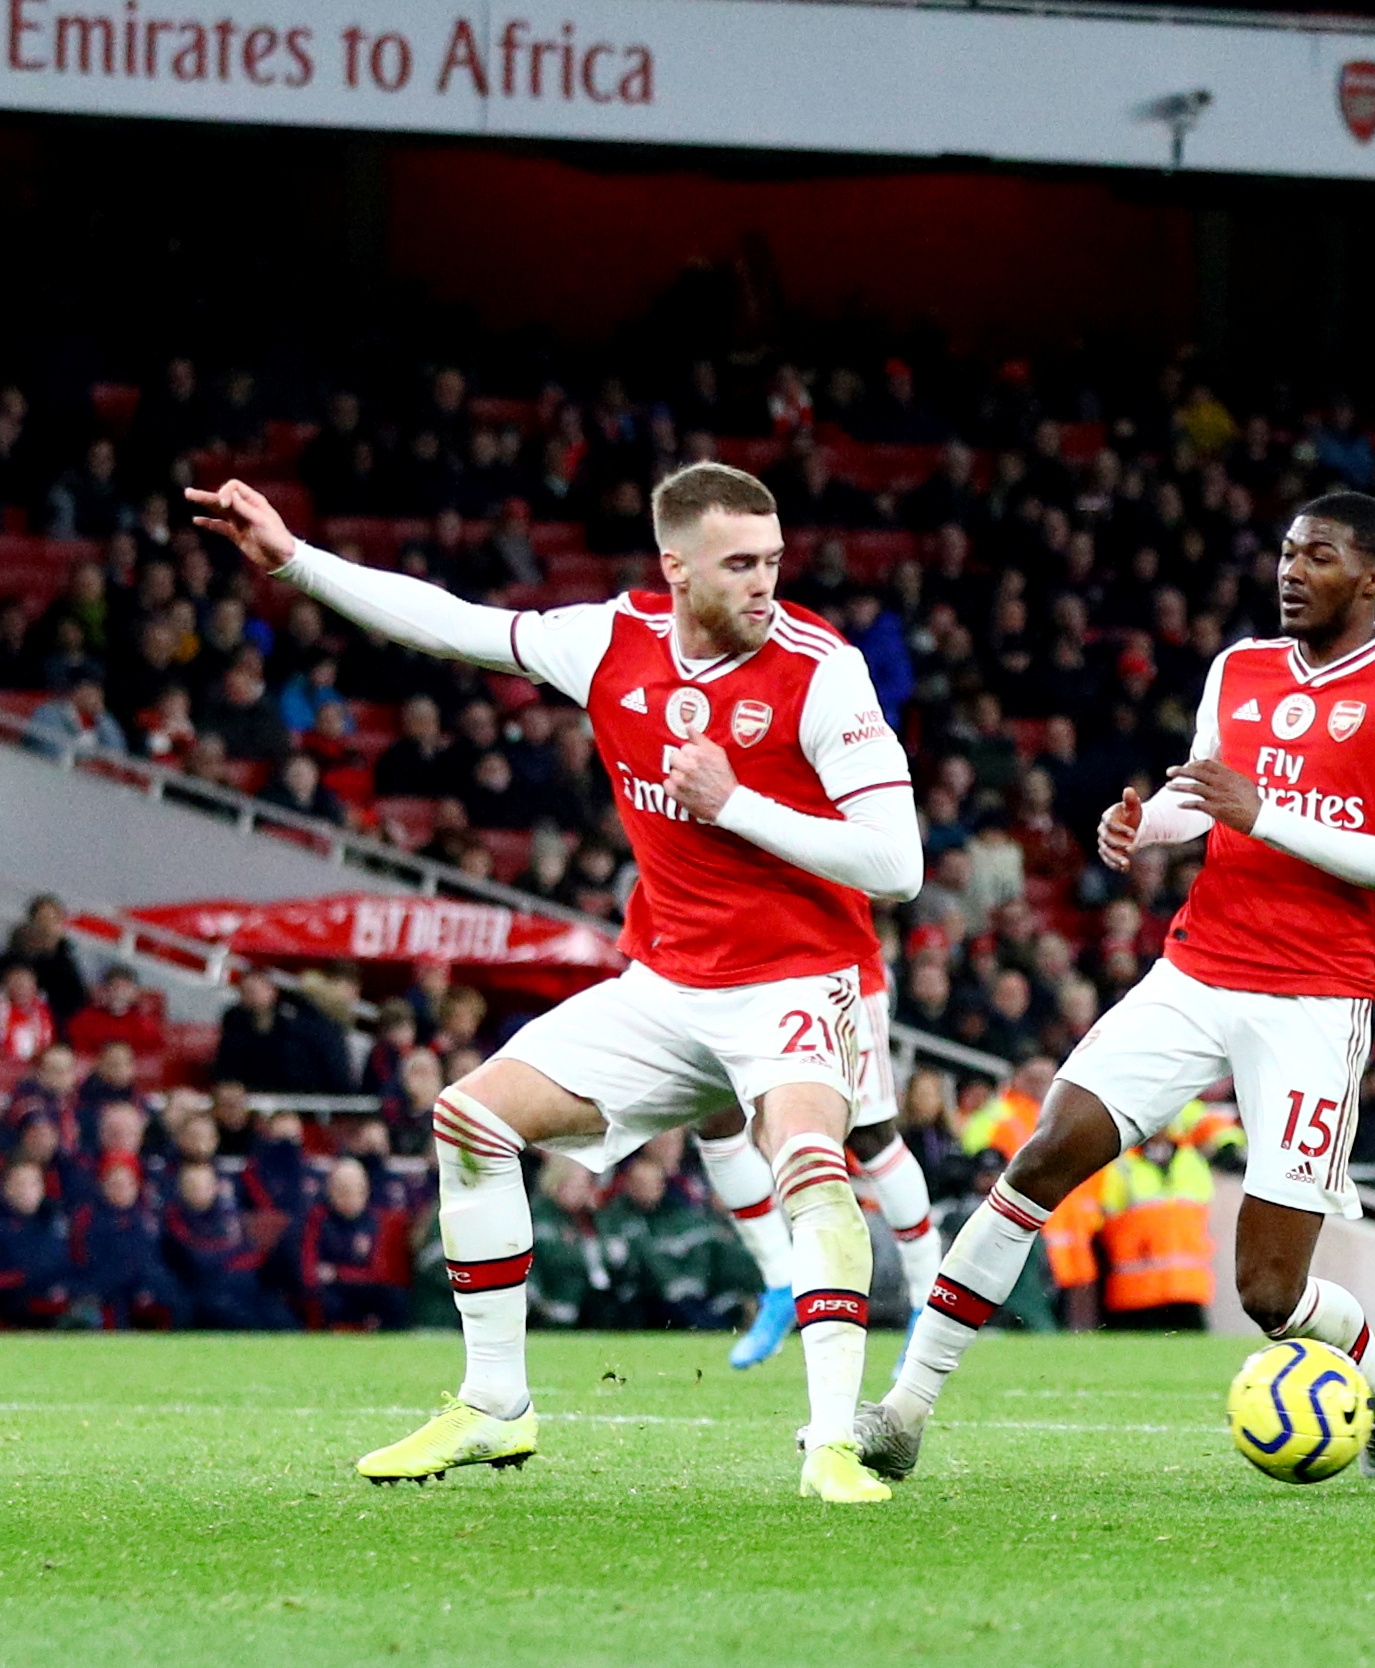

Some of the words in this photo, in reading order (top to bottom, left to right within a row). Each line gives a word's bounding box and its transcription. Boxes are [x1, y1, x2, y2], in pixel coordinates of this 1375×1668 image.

[5, 0, 316, 88] Emirates
[343, 24, 412, 92] to
[437, 18, 655, 105] Africa
[854, 710, 880, 724] VIS
[1256, 746, 1304, 784] Fly
[1257, 777, 1365, 829] irates
[1281, 1090, 1338, 1157] 15
[1285, 1172, 1316, 1184] adidas
